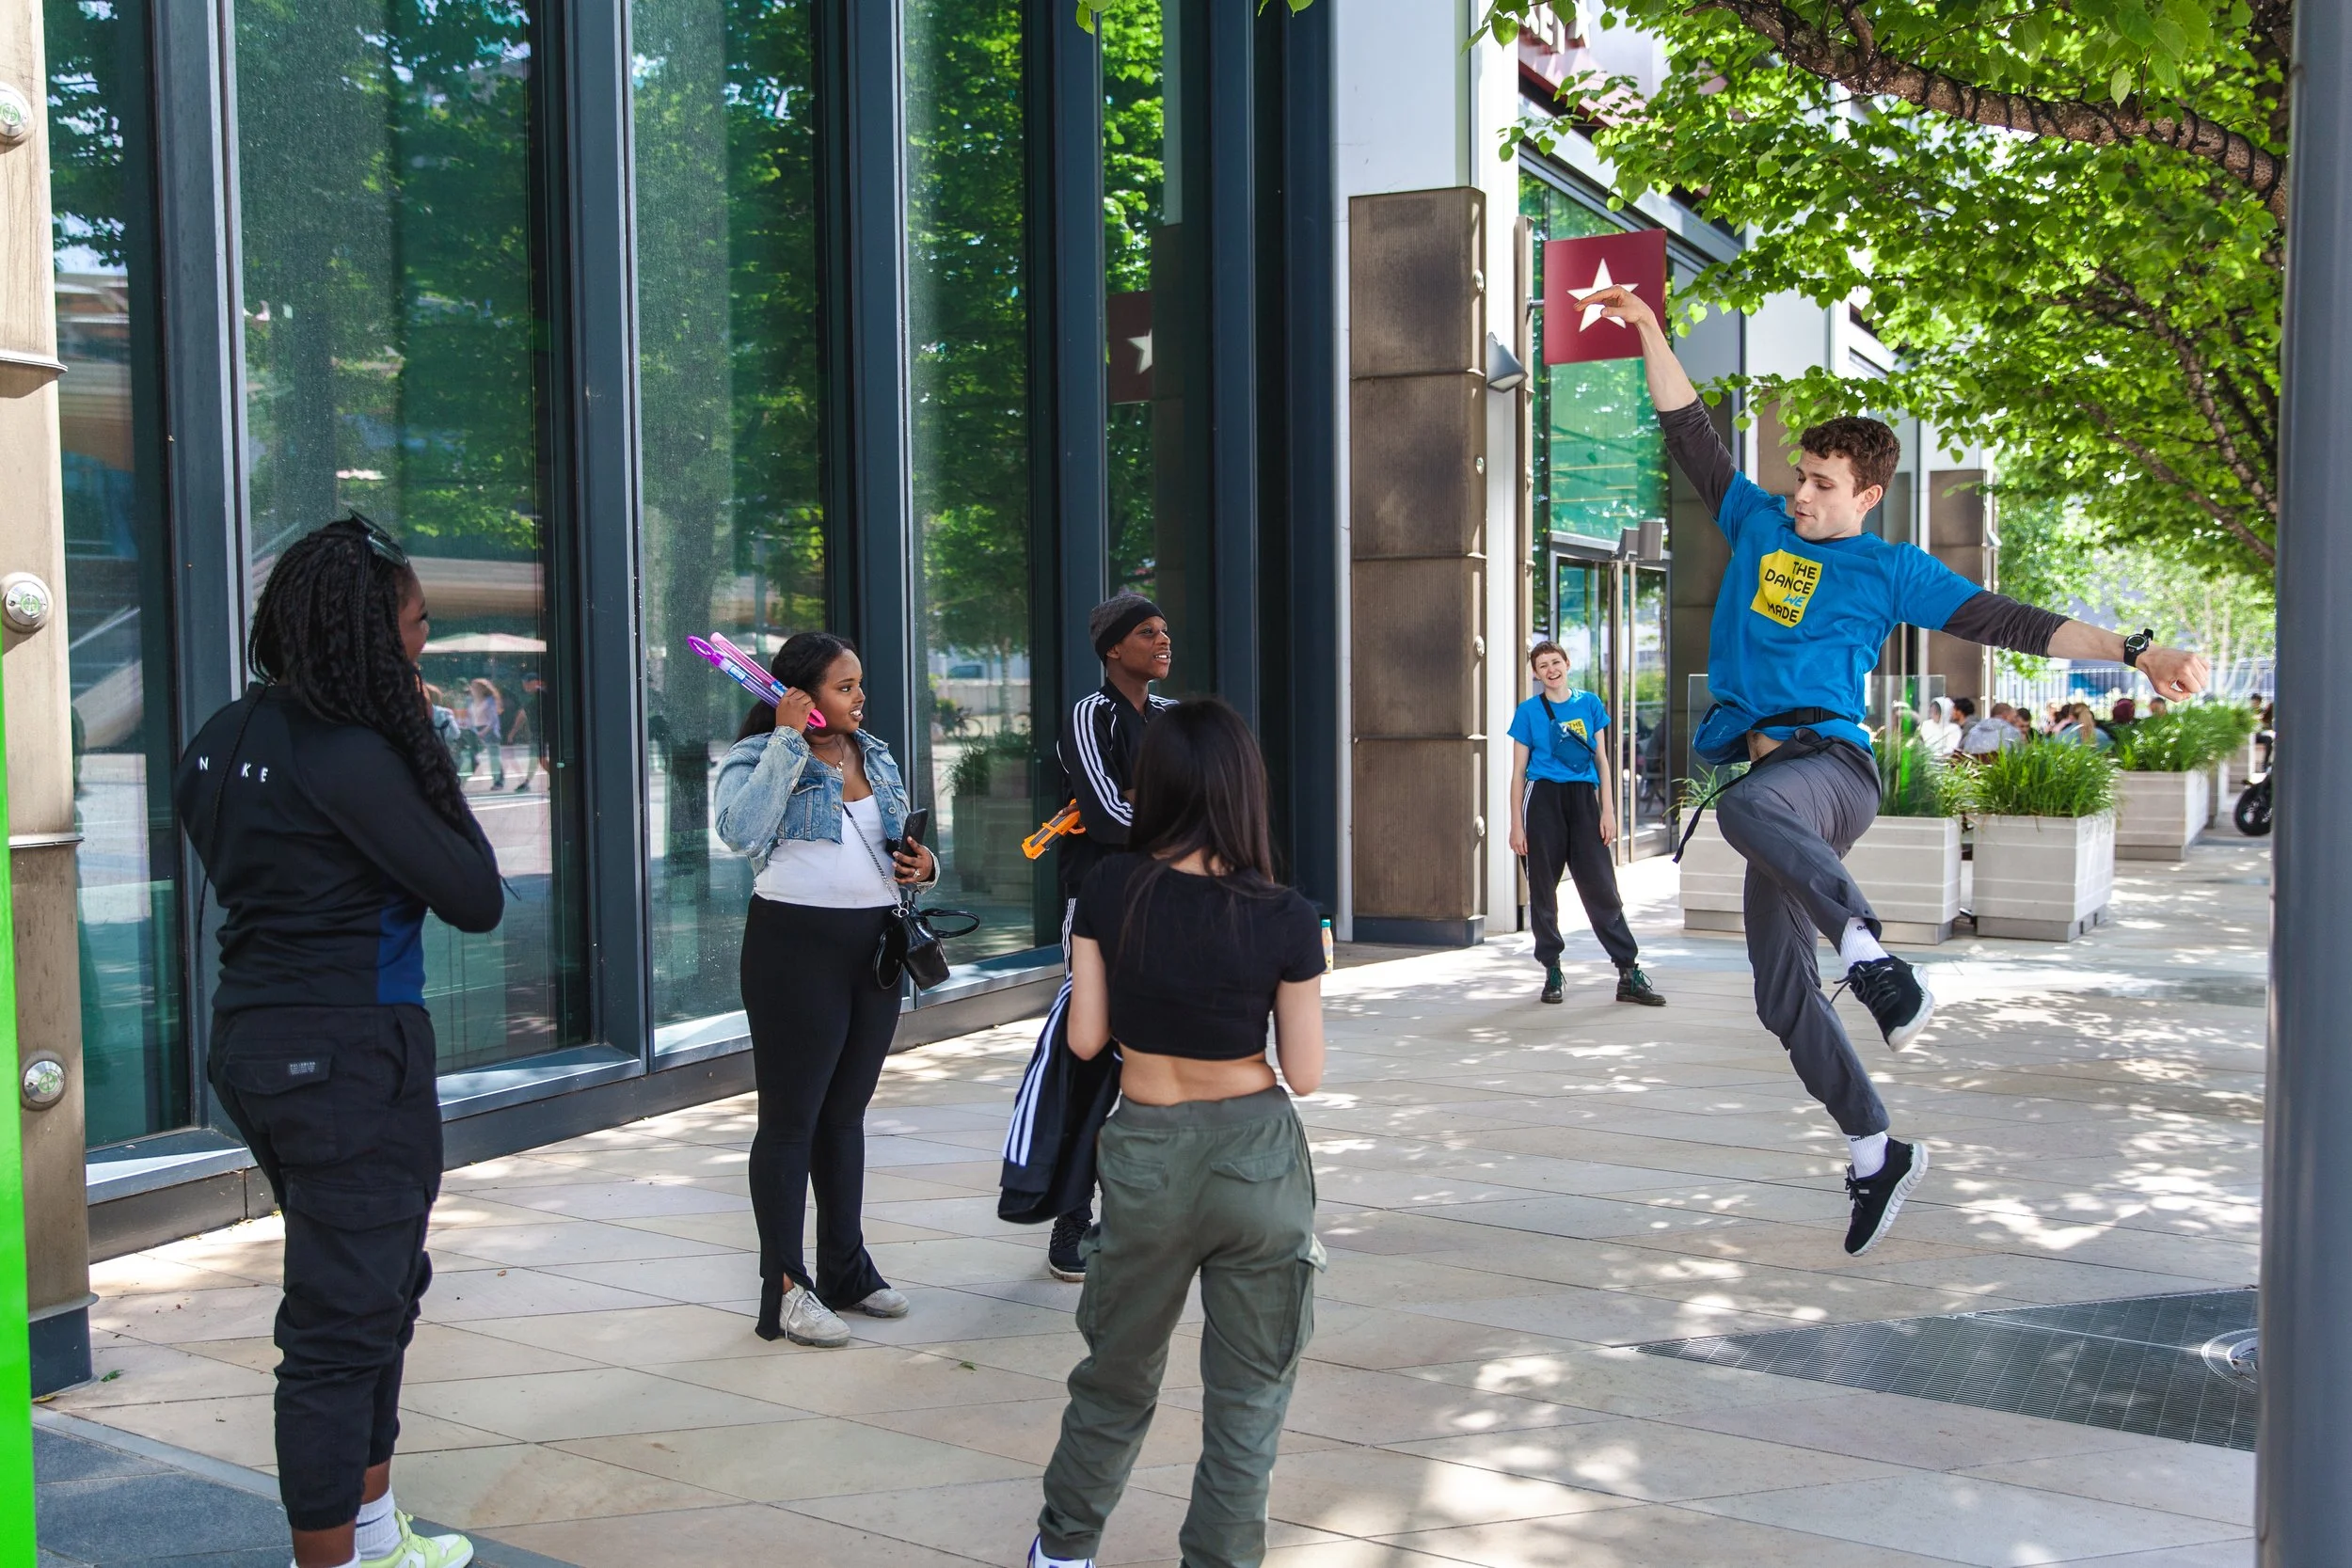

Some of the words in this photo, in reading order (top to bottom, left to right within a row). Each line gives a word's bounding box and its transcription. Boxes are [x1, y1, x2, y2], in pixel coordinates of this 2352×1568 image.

[1764, 568, 1813, 594] DANCE
[1793, 562, 1817, 579] THE
[1783, 594, 1805, 608] WE
[1767, 602, 1800, 623] MADE
[199, 756, 268, 783] NKE
